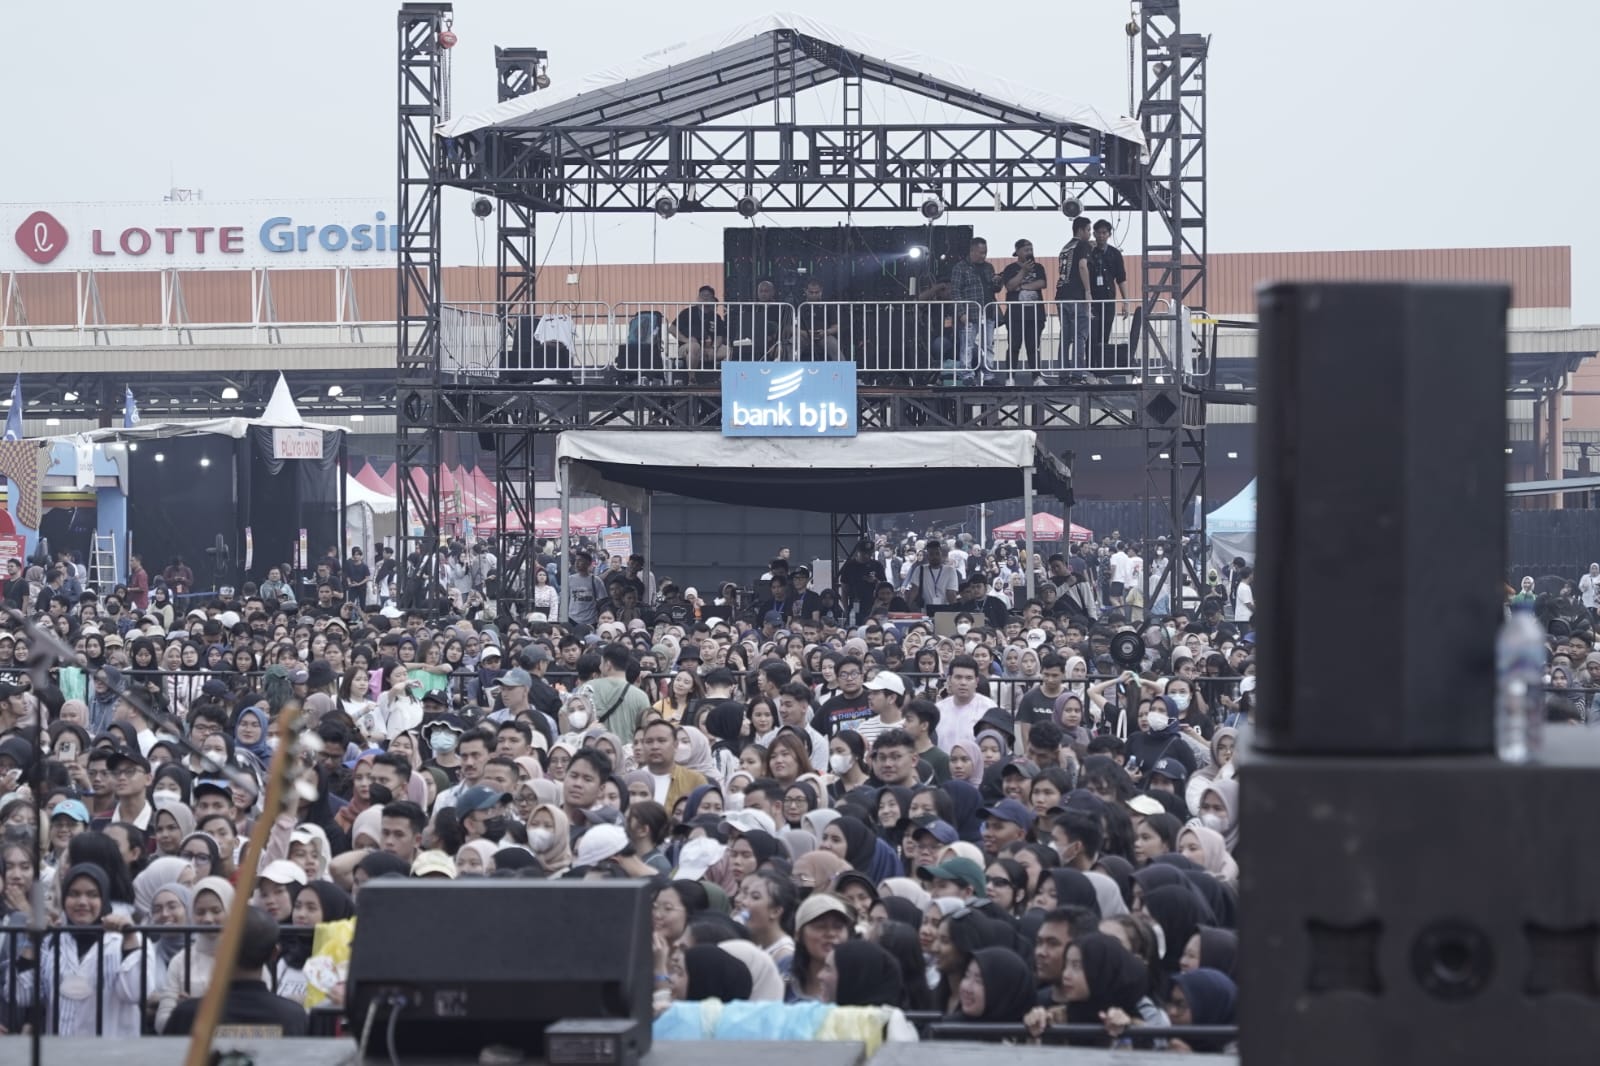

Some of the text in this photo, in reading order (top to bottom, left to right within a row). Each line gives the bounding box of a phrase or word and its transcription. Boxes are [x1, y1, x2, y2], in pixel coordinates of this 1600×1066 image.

[92, 226, 244, 256] LOTTE
[733, 401, 848, 433] bank bjb
